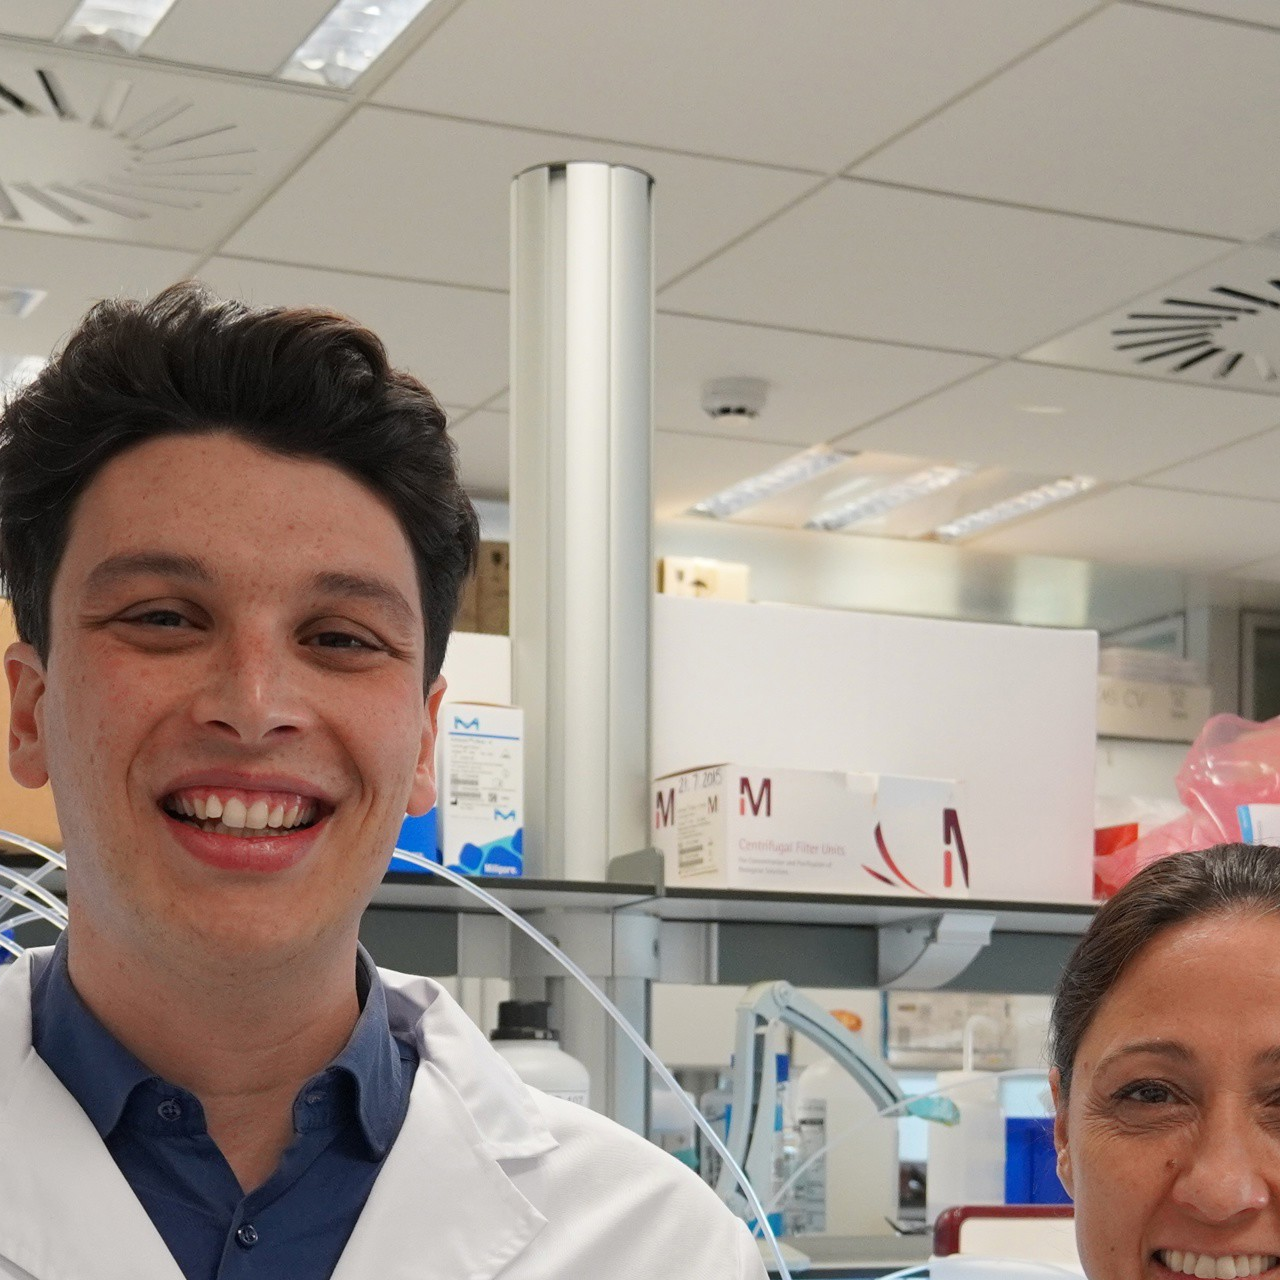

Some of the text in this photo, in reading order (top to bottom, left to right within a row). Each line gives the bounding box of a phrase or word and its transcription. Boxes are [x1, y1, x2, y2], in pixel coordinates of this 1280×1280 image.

[738, 838, 846, 856] Centrifugal Filter Units
